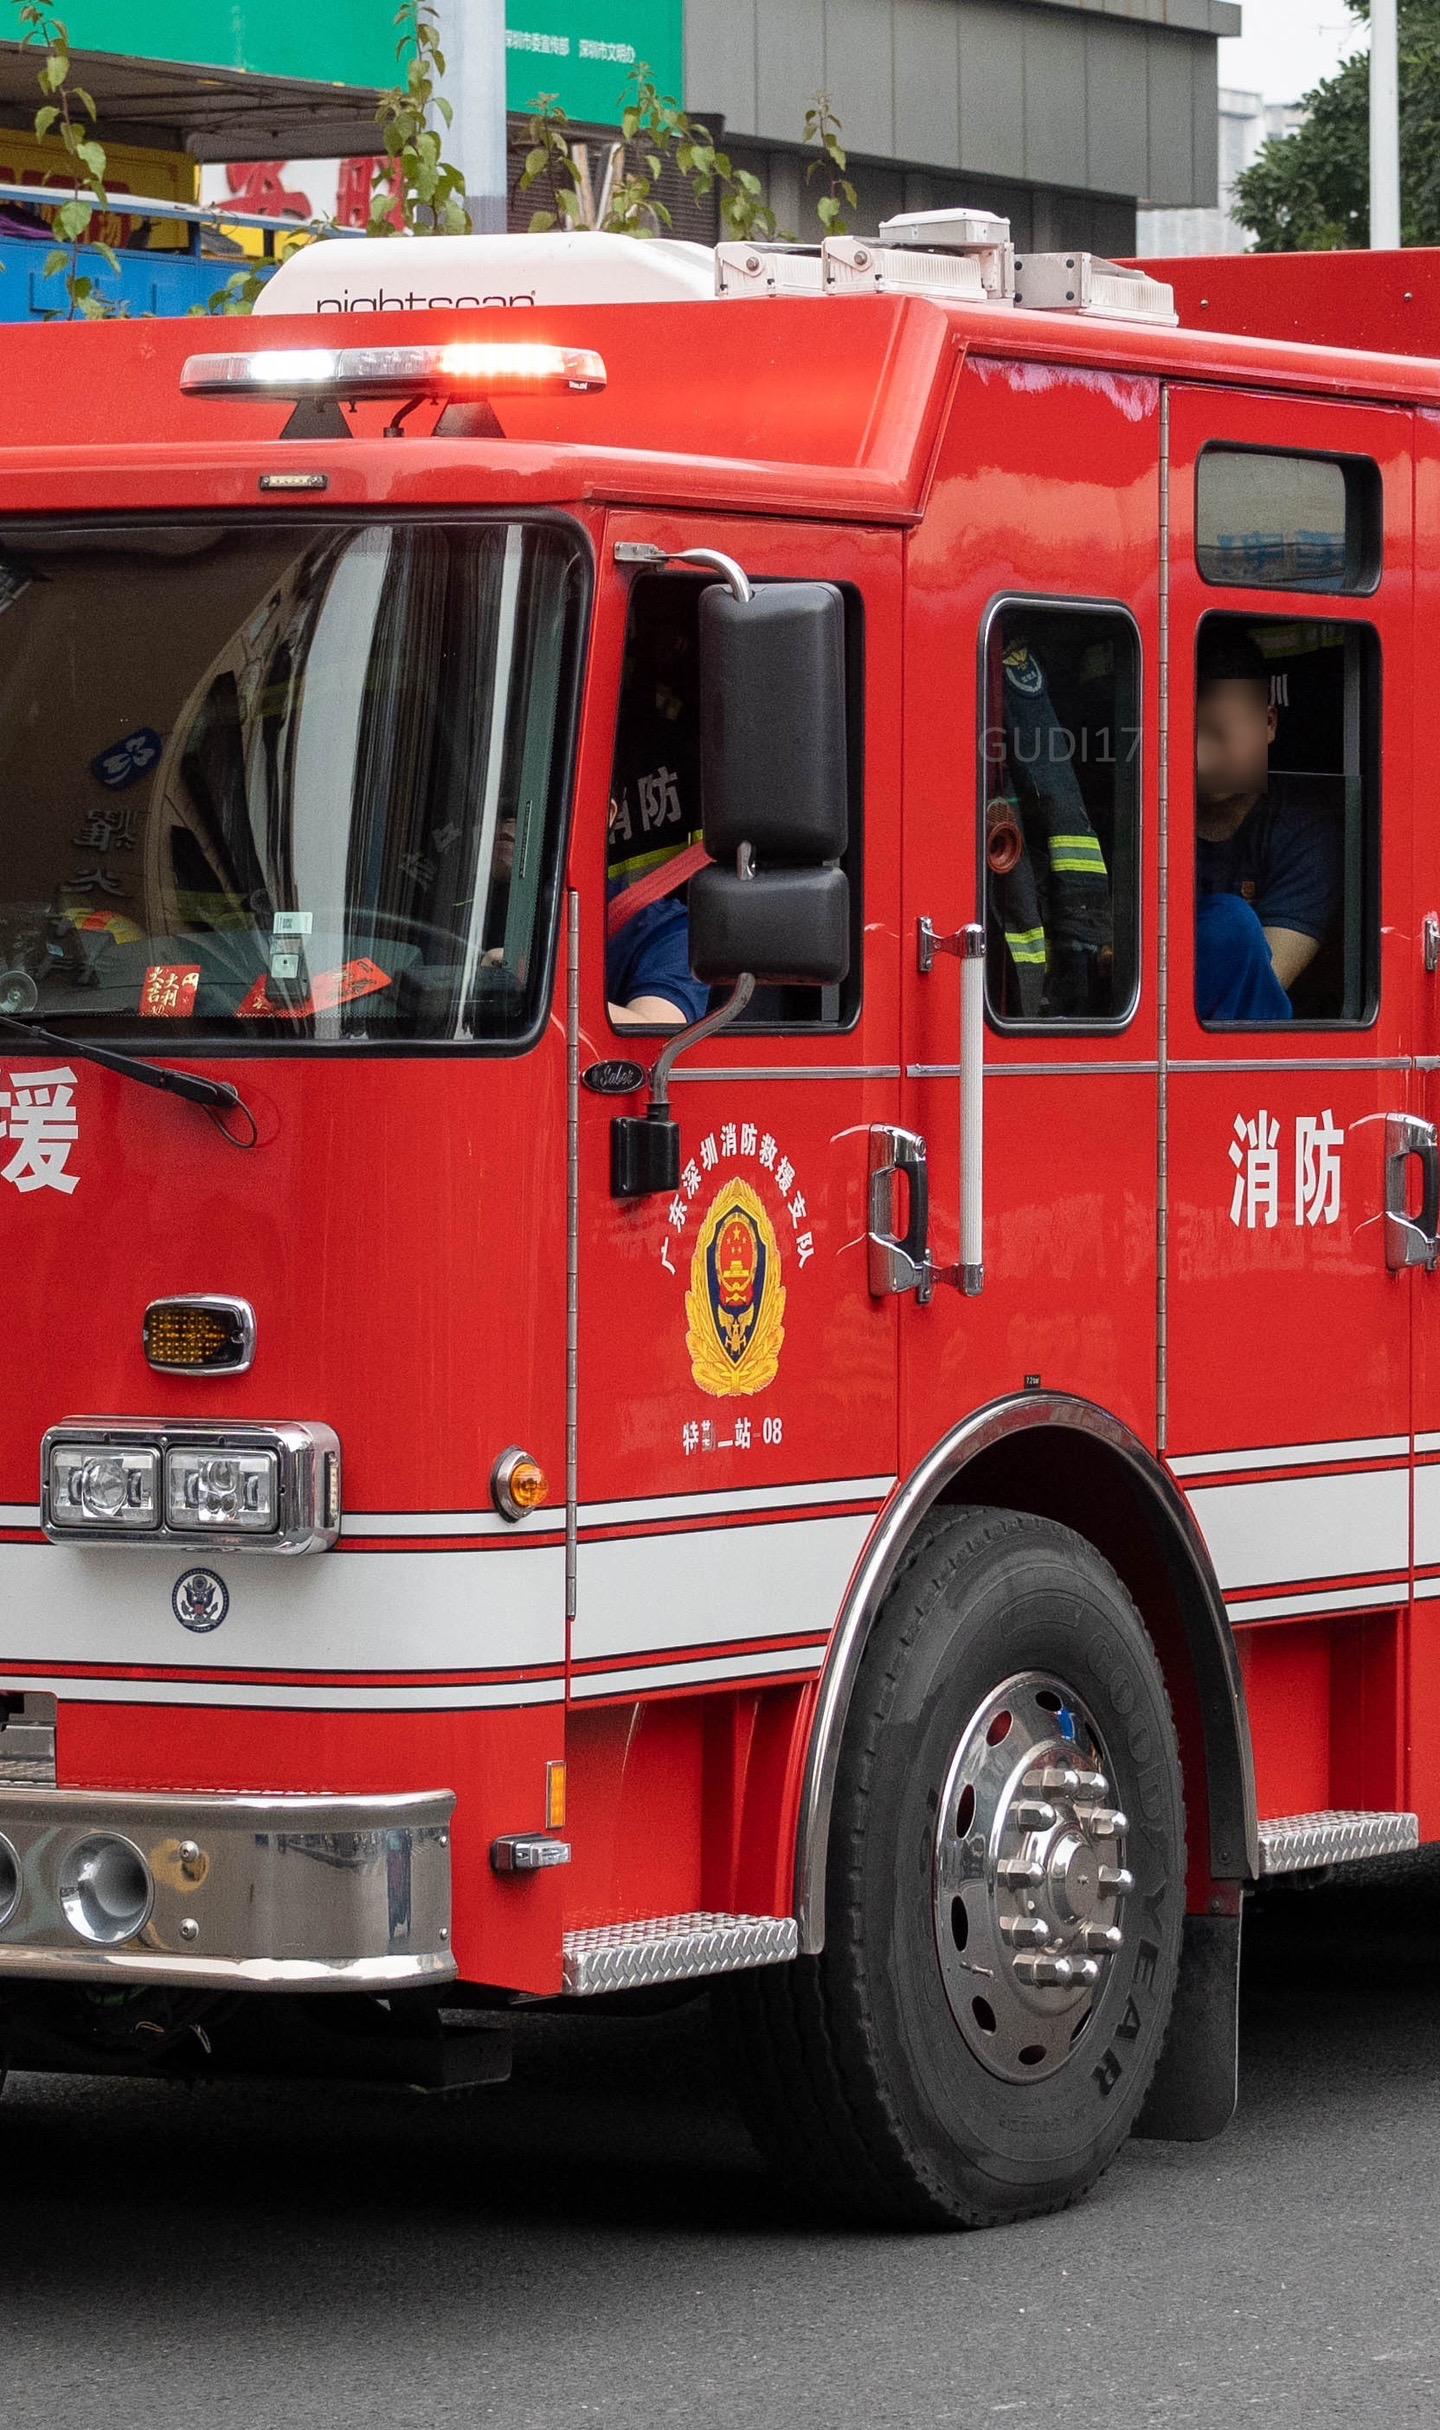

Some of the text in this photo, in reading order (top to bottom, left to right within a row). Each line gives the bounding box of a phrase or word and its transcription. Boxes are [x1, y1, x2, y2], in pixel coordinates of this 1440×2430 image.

[0, 1066, 81, 1195] 援
[1227, 1108, 1344, 1229] 消防
[660, 1122, 815, 1276] 广东深圳消防救援支队
